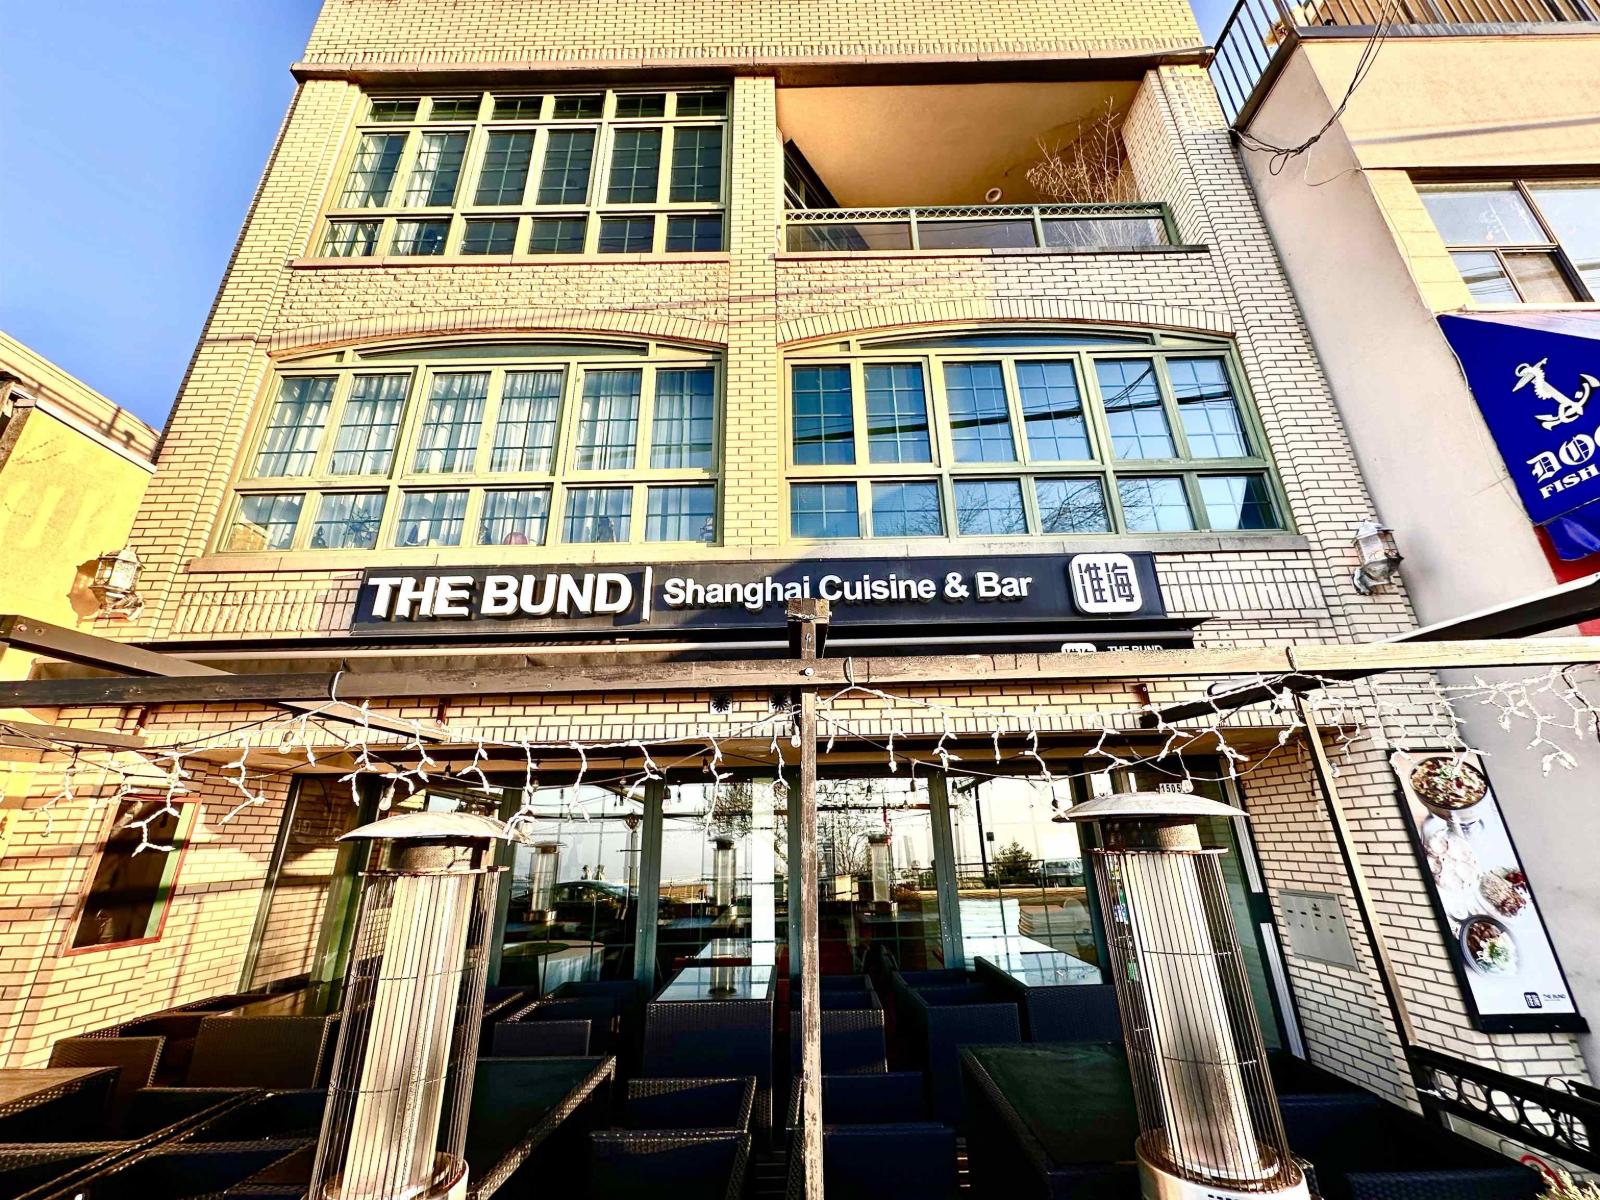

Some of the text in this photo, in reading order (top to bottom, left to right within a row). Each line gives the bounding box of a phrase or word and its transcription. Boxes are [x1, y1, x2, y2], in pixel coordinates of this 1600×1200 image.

[1526, 425, 1600, 484] DO
[1539, 463, 1600, 499] FISH
[368, 571, 1033, 618] THE BUND Shanghai Cuisine & Bar
